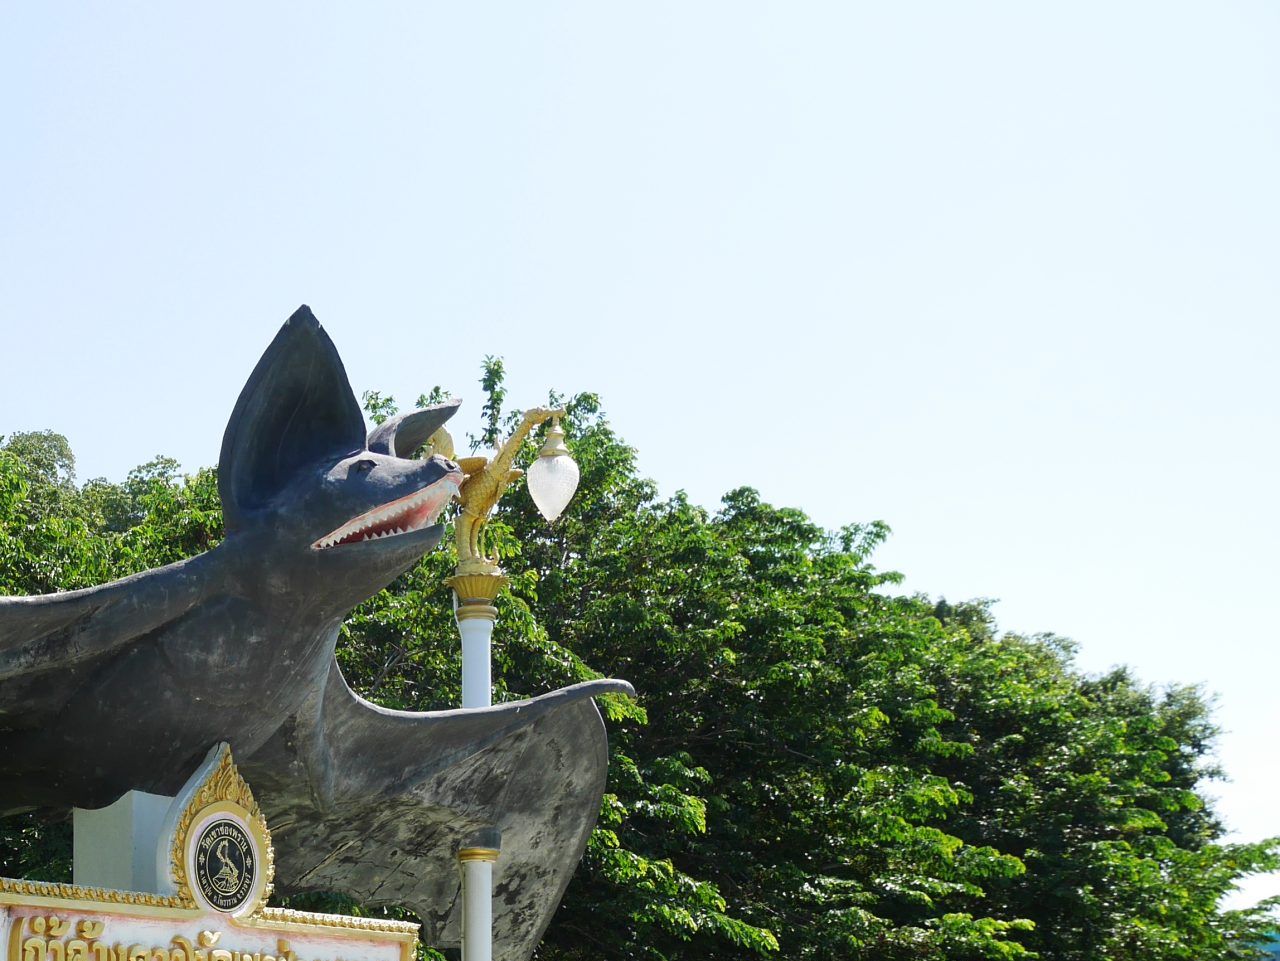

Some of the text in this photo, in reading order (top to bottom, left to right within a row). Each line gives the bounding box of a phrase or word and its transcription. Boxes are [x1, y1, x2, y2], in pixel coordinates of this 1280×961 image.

[201, 822, 248, 852] วัดเขาช่องพราน
